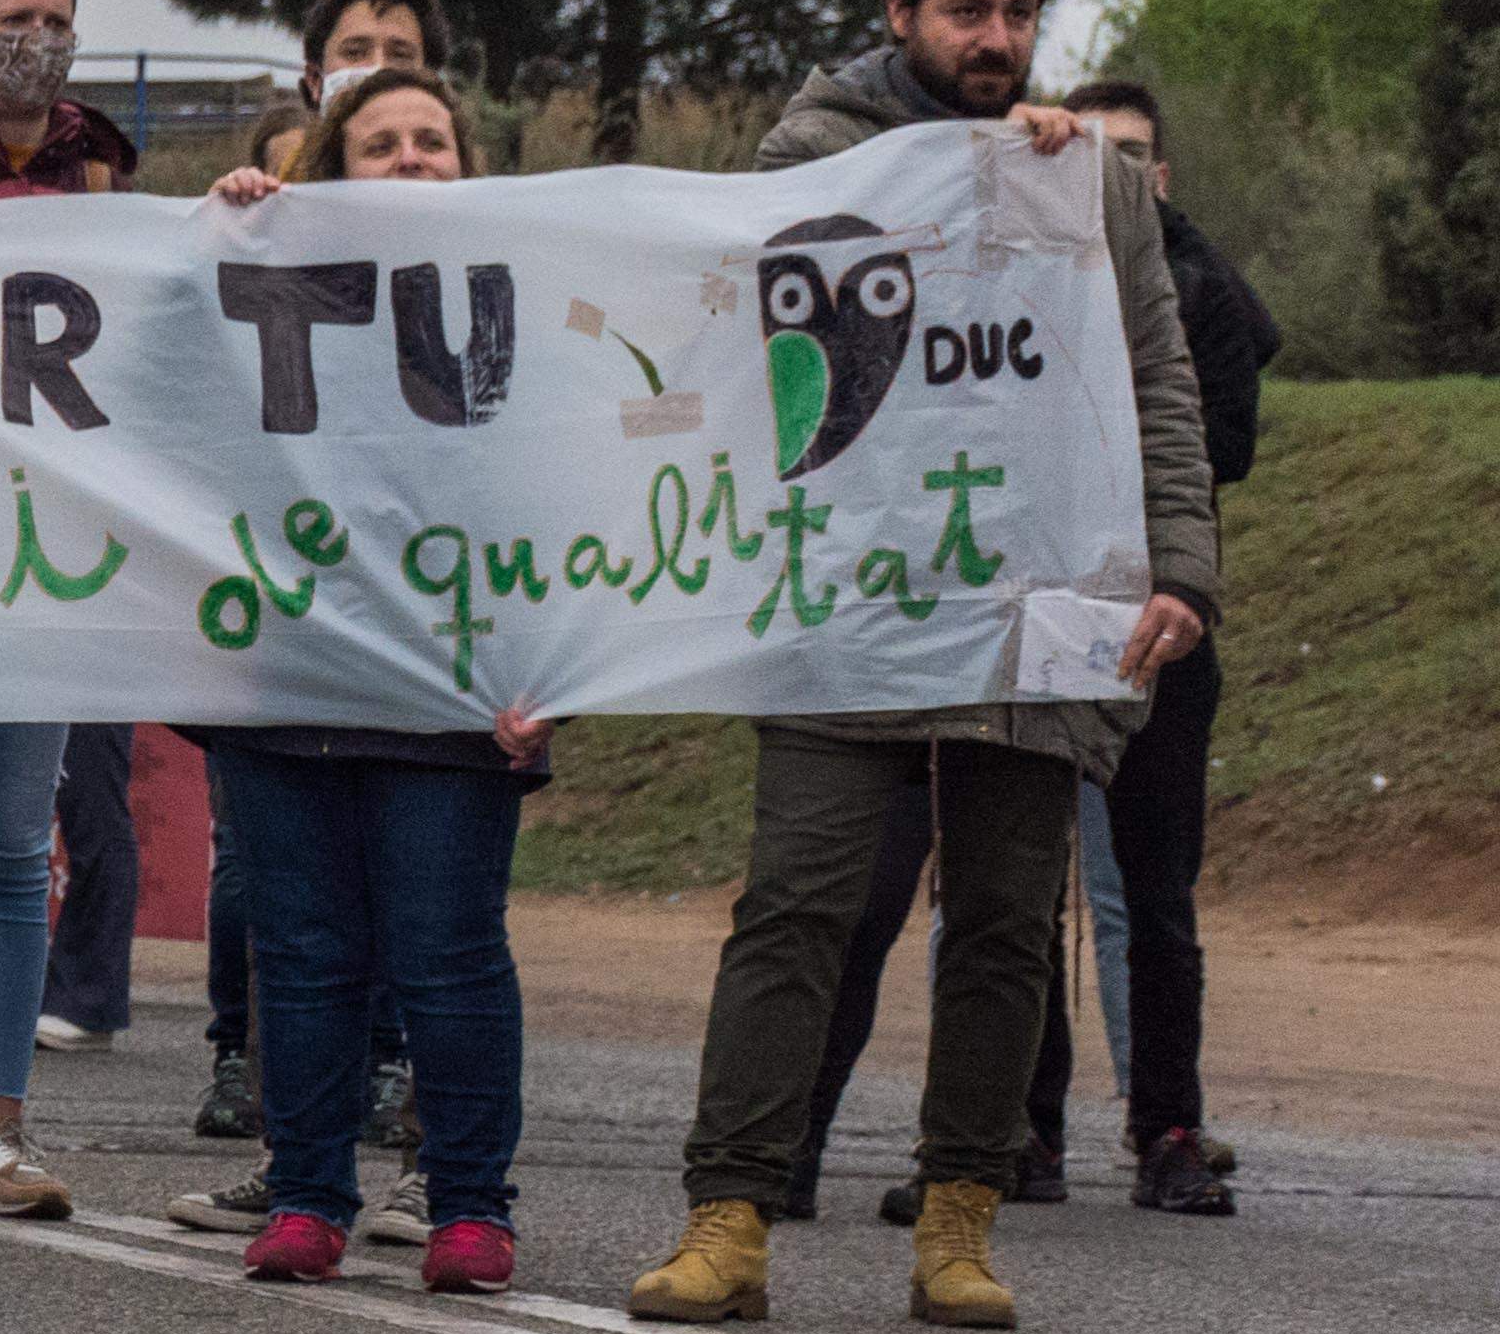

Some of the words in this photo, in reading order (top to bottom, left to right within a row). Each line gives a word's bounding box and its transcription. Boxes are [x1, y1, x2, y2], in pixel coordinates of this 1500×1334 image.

[217, 261, 516, 435] TU
[924, 322, 1044, 386] DUC
[197, 498, 348, 651] de
